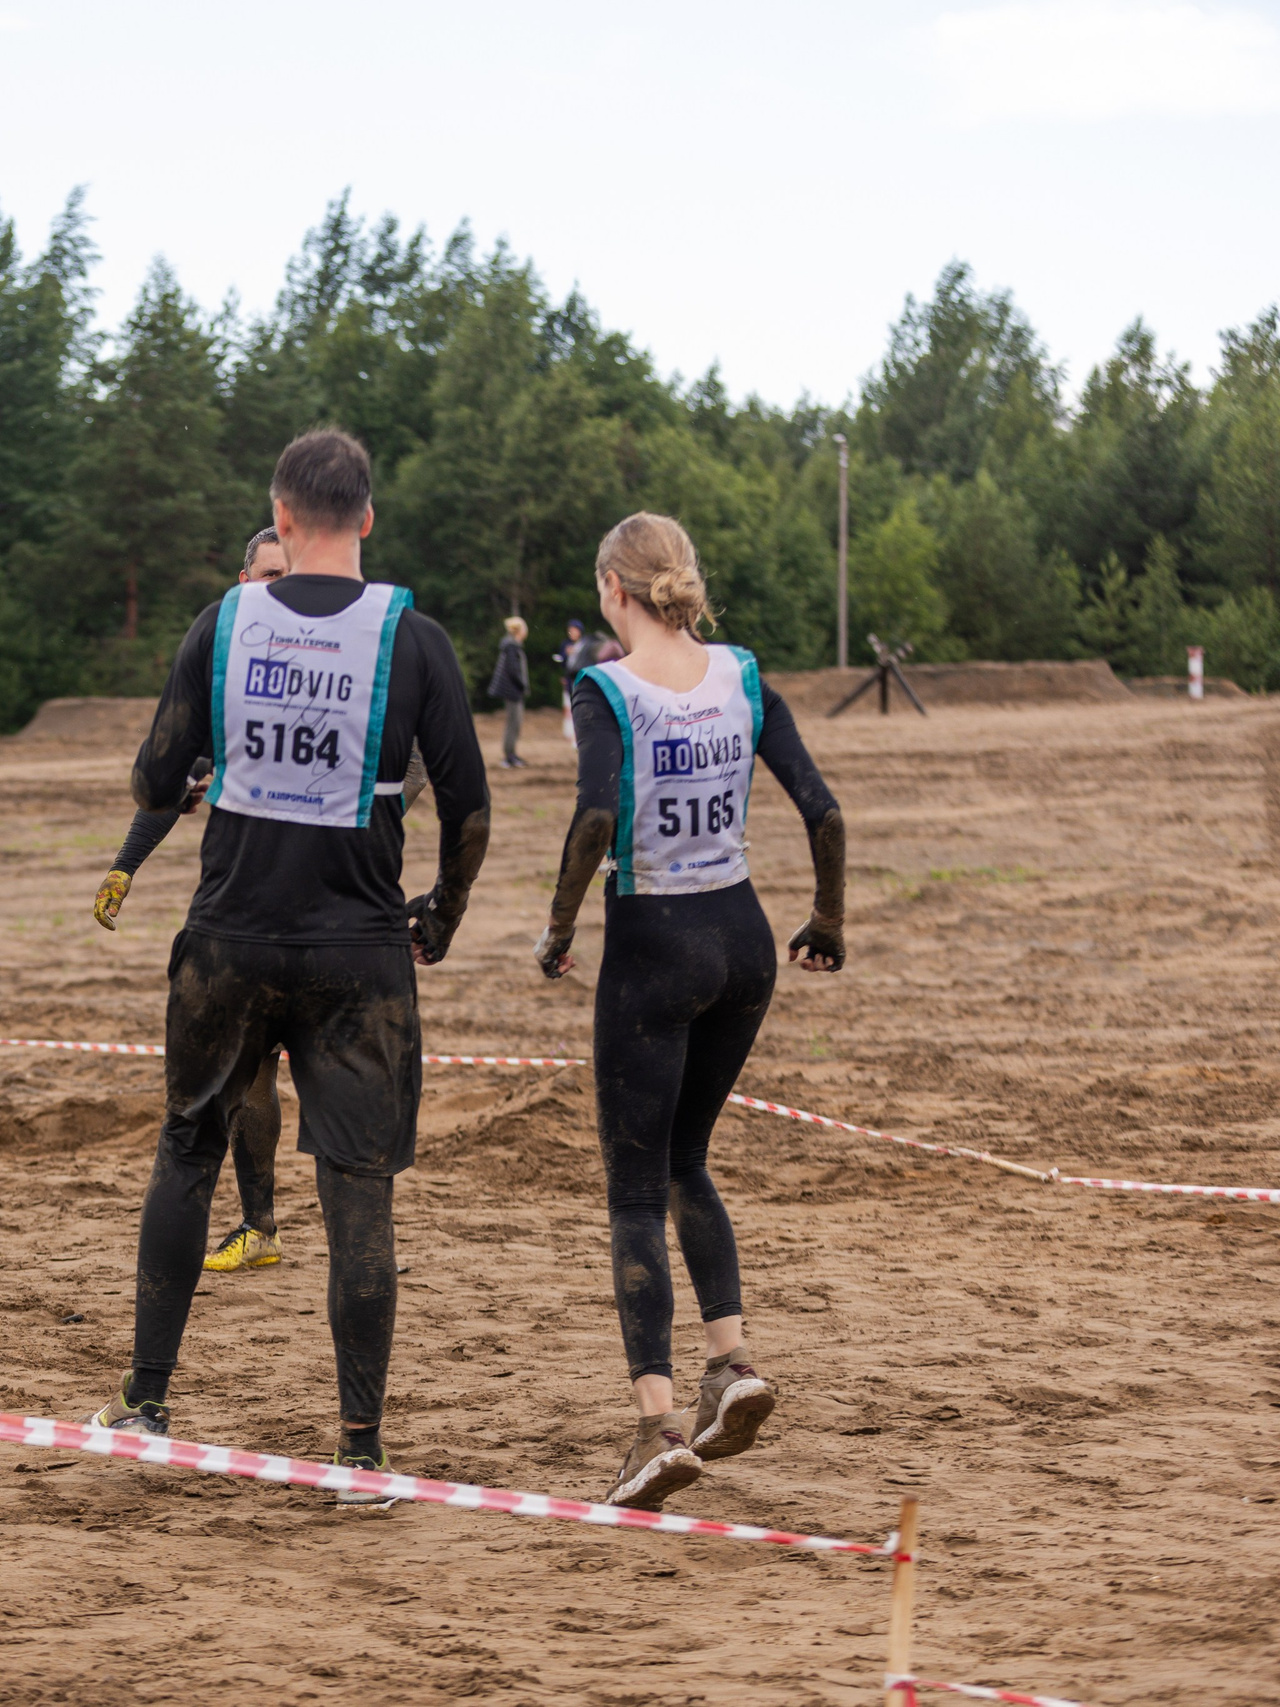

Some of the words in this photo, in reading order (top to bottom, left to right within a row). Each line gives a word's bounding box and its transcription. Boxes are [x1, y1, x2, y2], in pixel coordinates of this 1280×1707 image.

[303, 638, 340, 650] ГЕРОЕВ
[247, 663, 353, 702] RODVIG
[244, 720, 340, 769] 5164
[656, 734, 741, 772] RODVIG
[658, 789, 734, 838] 5165
